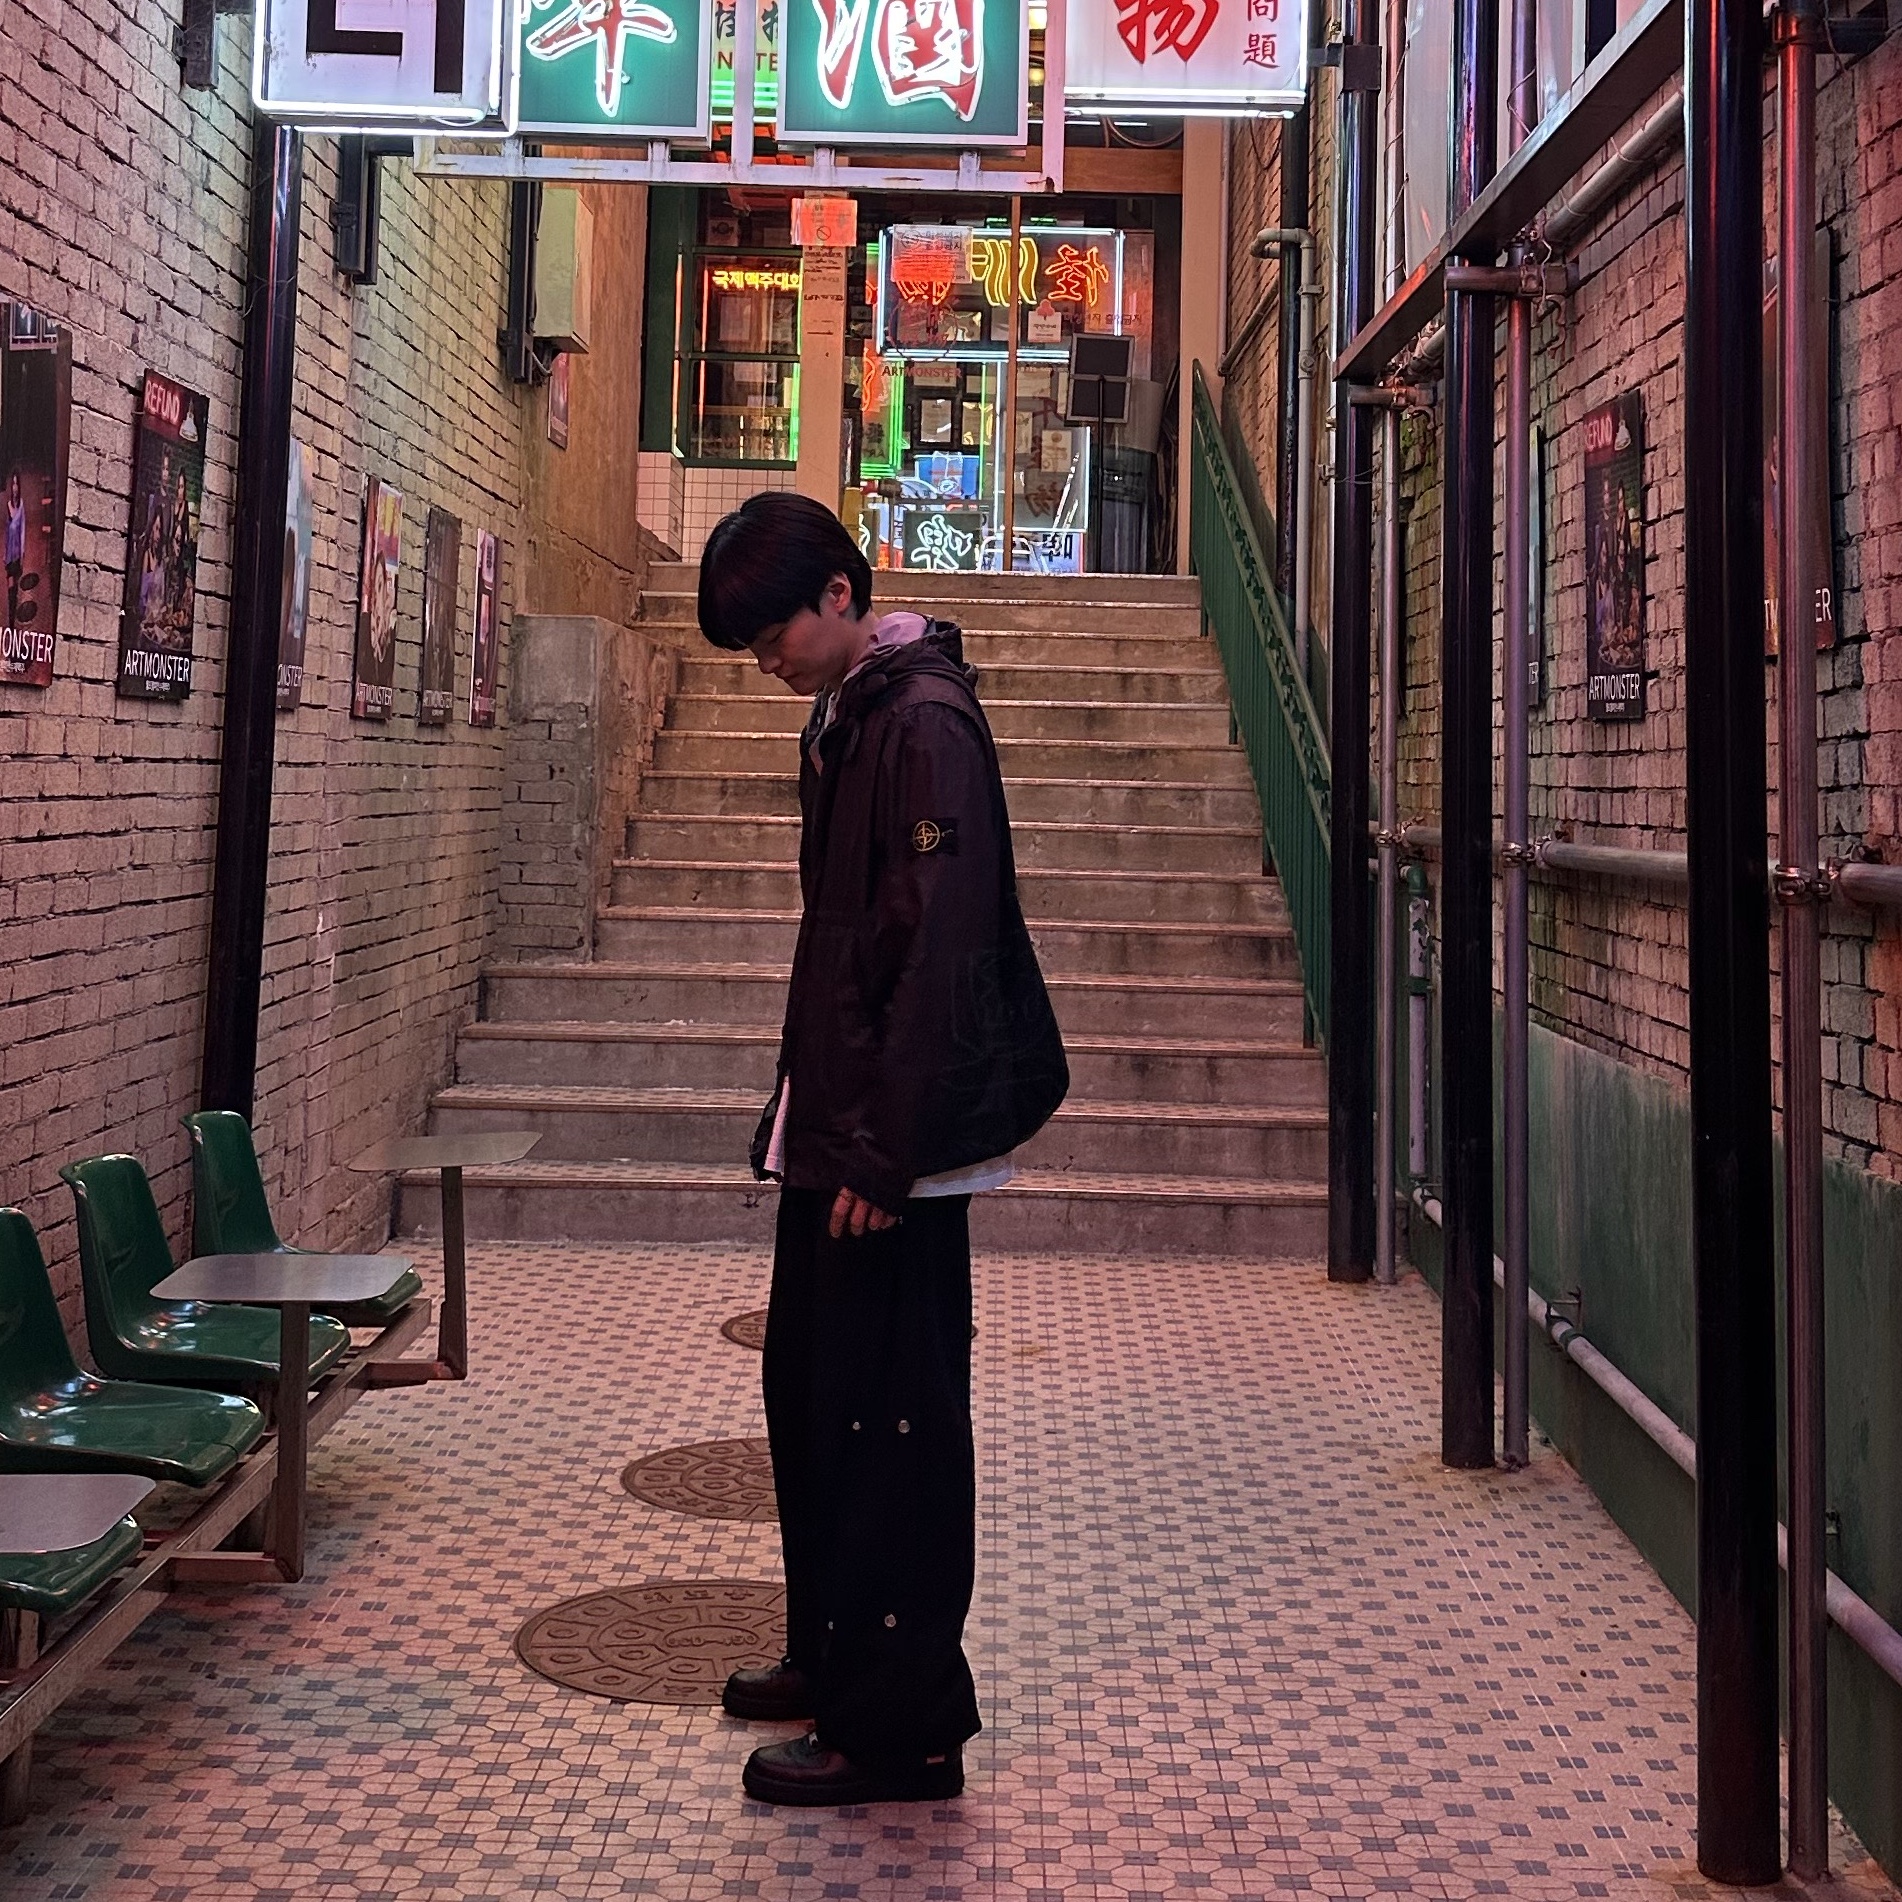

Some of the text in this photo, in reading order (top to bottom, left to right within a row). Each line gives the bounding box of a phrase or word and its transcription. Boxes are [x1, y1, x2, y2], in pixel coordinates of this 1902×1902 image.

[0, 627, 53, 663] ONSTER
[123, 649, 190, 683] ARTMONSTER
[1588, 673, 1641, 700] ARTMONSTER
